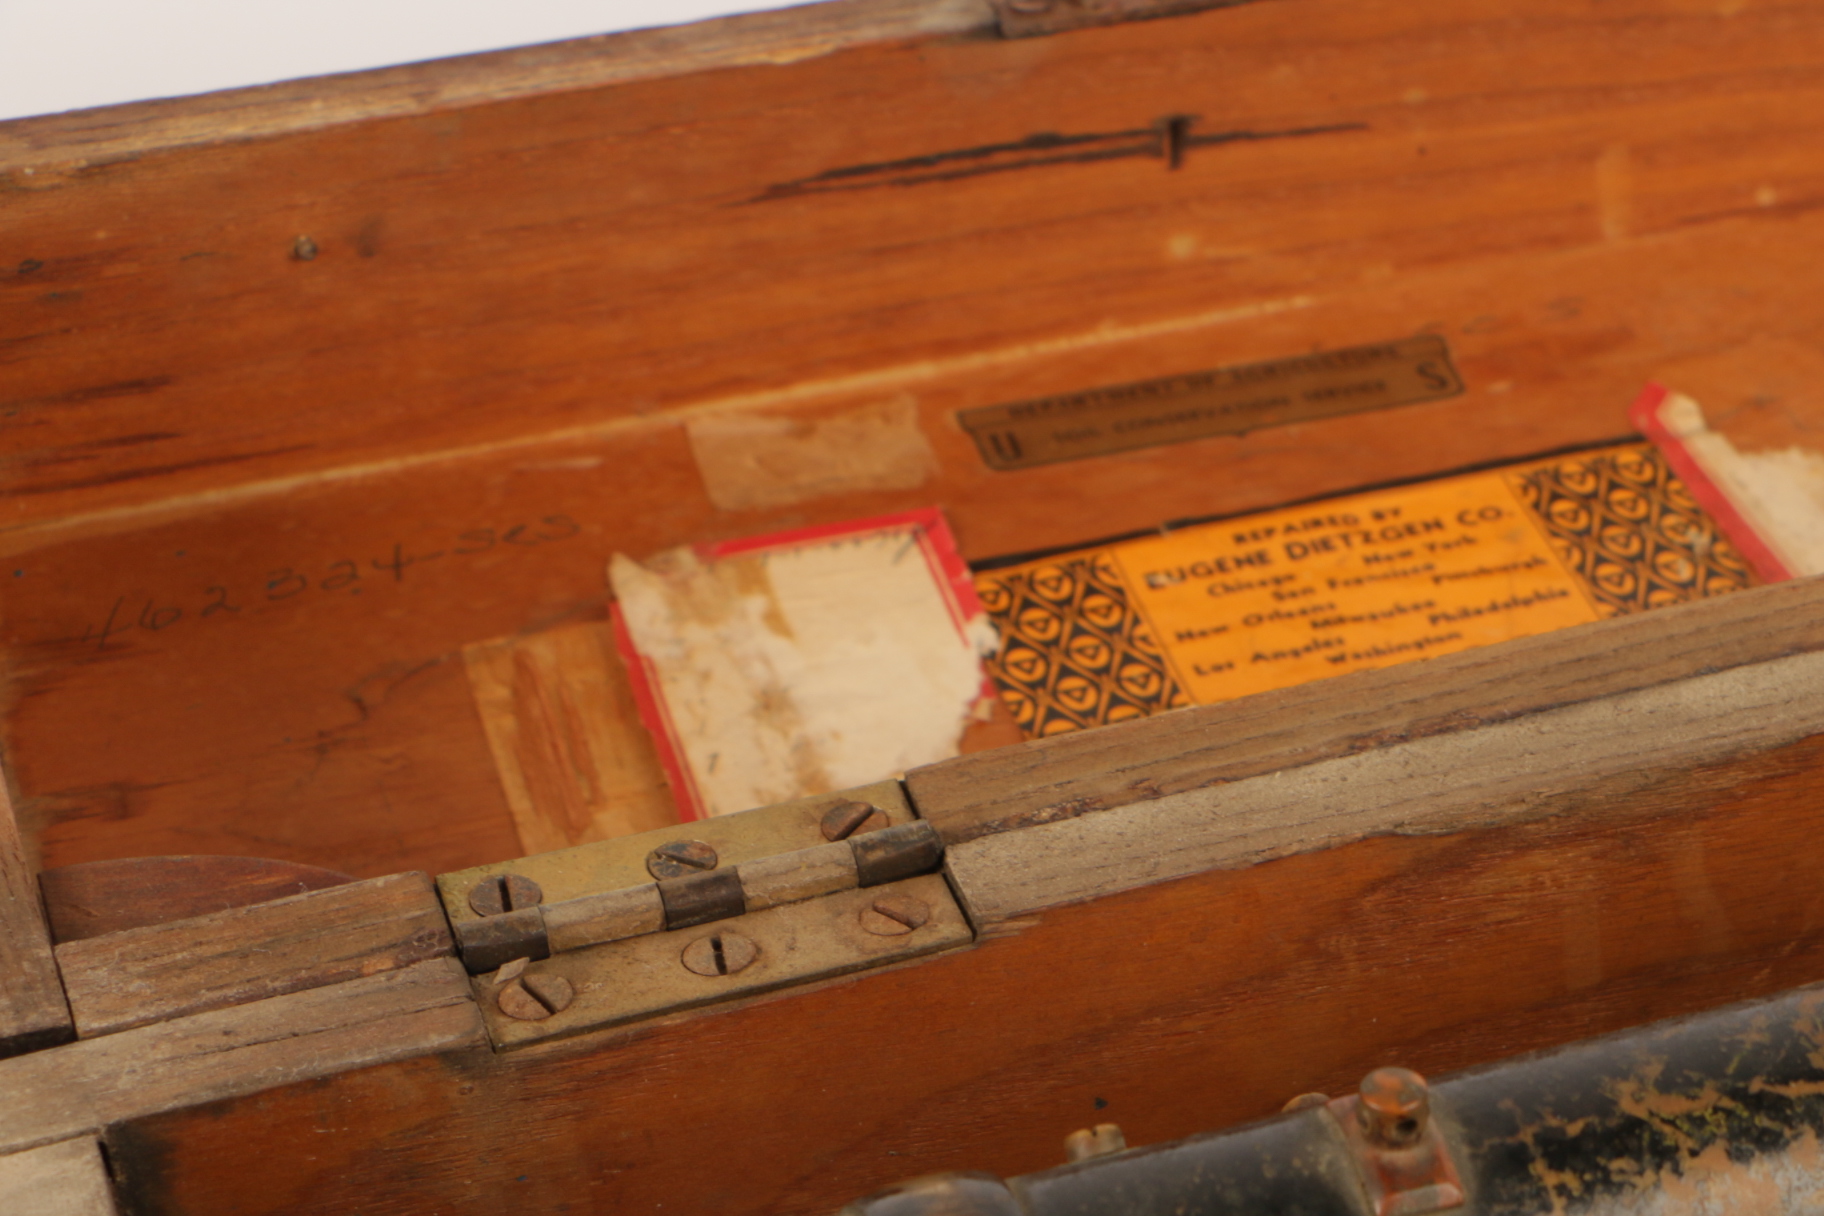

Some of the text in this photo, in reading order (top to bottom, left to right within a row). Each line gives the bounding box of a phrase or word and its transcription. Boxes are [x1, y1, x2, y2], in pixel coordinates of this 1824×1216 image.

[1416, 362, 1448, 391] S
[988, 432, 1022, 461] U
[1232, 507, 1401, 545] REPAIRED BY
[1143, 550, 1272, 590] EUGENE
[1284, 518, 1445, 561] DIETZGEN
[1207, 536, 1477, 597] Chicago New York
[1271, 563, 1436, 602] San Francisco
[1175, 624, 1230, 643] New
[1242, 603, 1337, 627] Orleans
[1429, 589, 1569, 626] Philadelphia
[1192, 637, 1345, 676] Los Angeles
[1325, 632, 1463, 664] Washington
